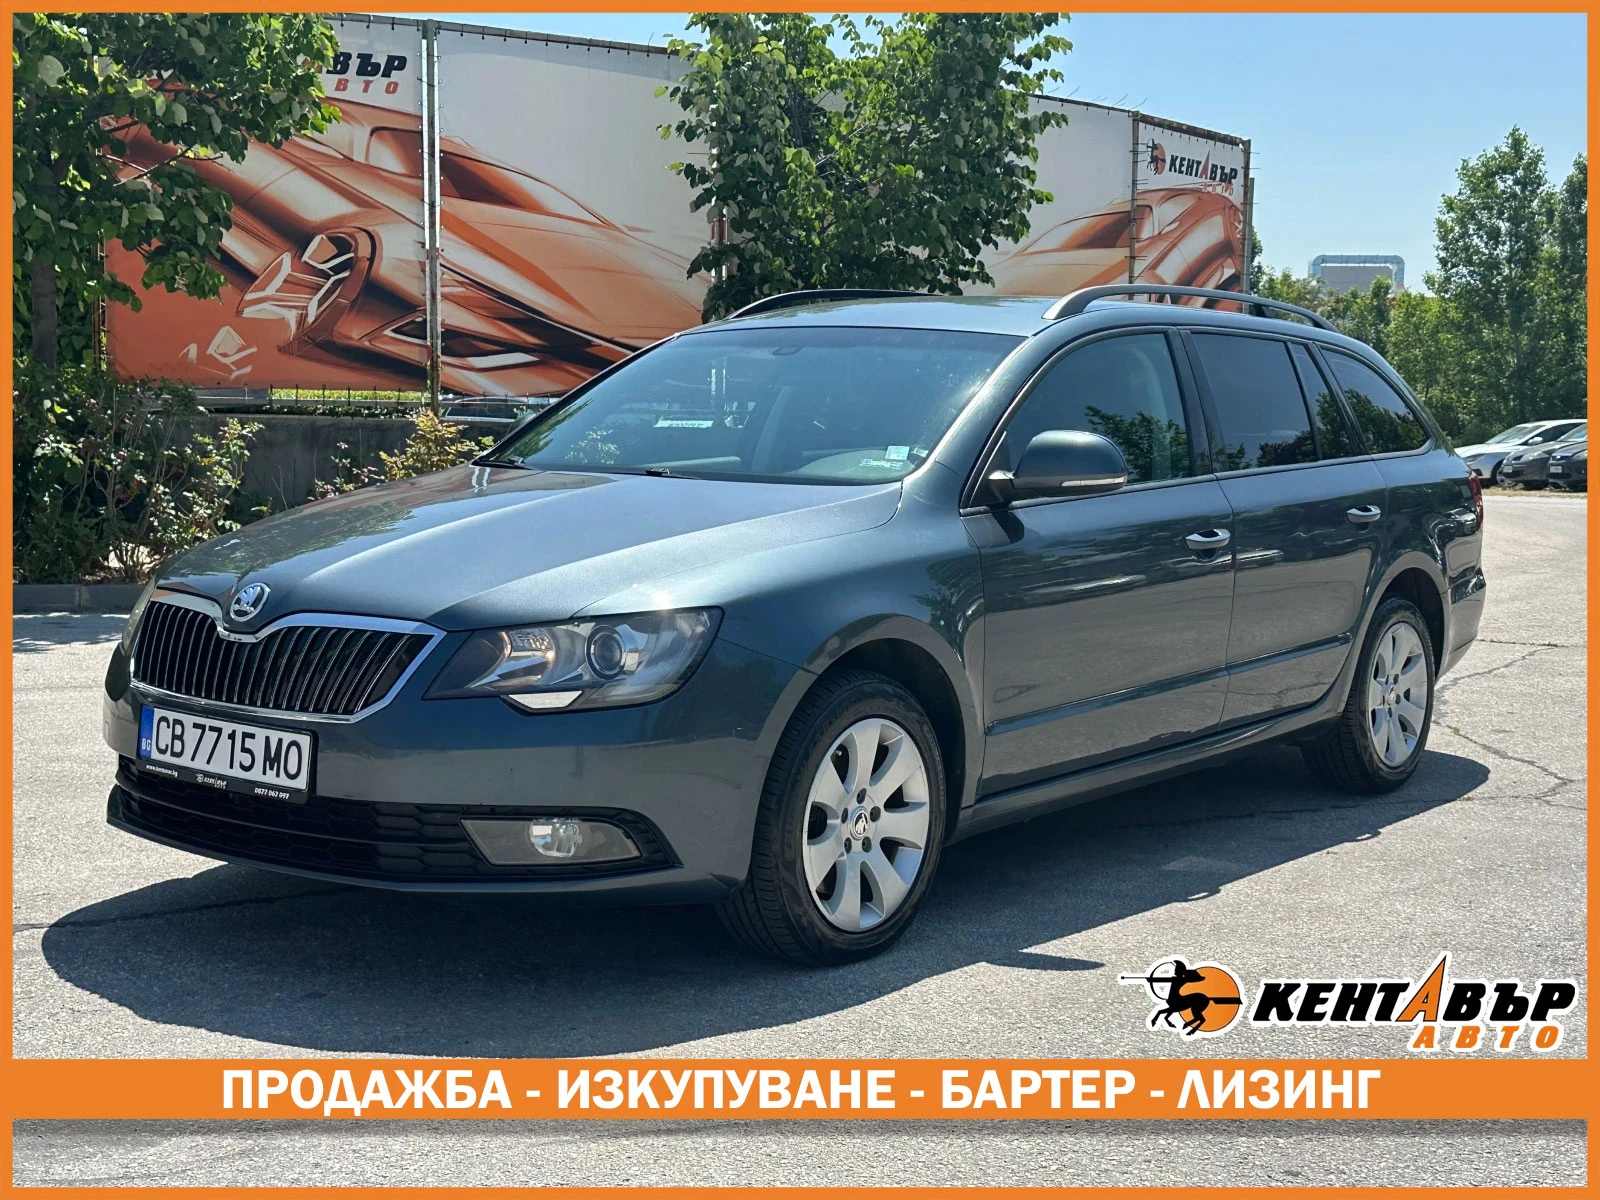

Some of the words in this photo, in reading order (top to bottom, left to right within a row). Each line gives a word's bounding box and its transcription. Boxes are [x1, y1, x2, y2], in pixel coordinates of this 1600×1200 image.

[302, 51, 408, 78] ВЪР
[334, 78, 400, 95] ВТО
[1168, 149, 1239, 185] КЕНТАВЪР
[141, 738, 151, 751] BG
[190, 722, 257, 773] 7715
